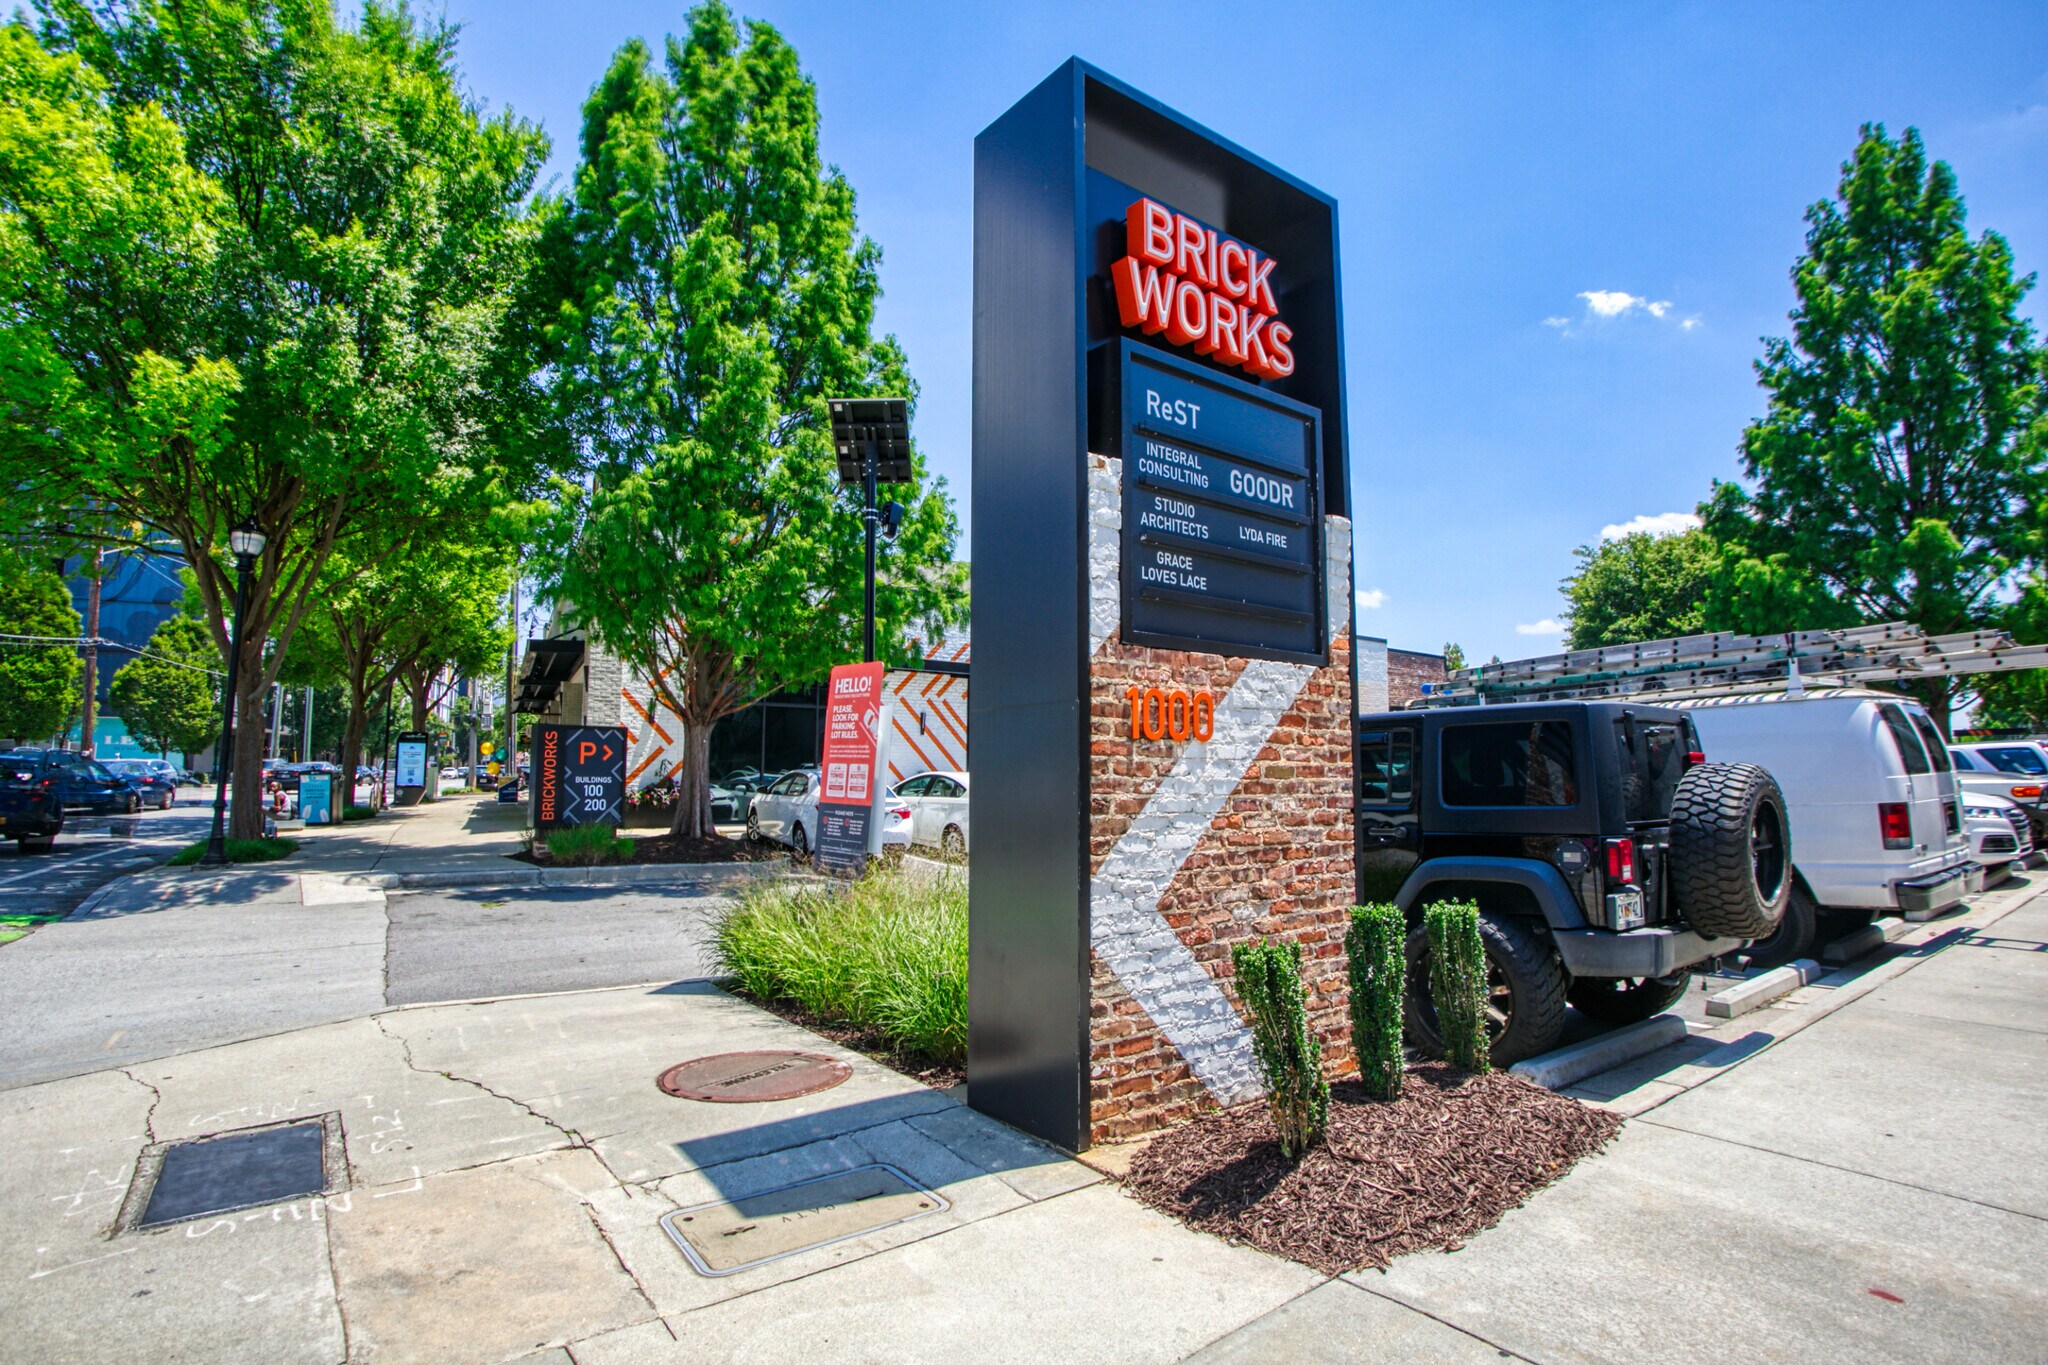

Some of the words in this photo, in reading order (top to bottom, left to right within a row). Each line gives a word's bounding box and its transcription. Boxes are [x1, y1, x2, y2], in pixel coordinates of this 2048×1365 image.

[1127, 197, 1279, 316] BRICK
[1111, 256, 1294, 380] WORKS
[1146, 389, 1200, 430] ReST
[1146, 441, 1202, 470] INTEGRAL
[1139, 458, 1209, 489] CONSULTING
[1229, 469, 1294, 508] GOODR
[1154, 497, 1195, 519] STUDIO
[1140, 511, 1209, 539] ARCHITECTS
[1239, 526, 1264, 544] LYDA
[1266, 533, 1287, 549] FIRE
[1156, 551, 1192, 571] GRACE
[1141, 566, 1177, 585] LOVES
[1180, 573, 1207, 591] LACE
[834, 676, 872, 694] HELLO!
[832, 714, 847, 722] LOOK
[848, 713, 859, 721] FOR
[1126, 685, 1214, 743] 1000
[830, 731, 841, 739] LOT
[841, 731, 858, 739] RULES.
[831, 722, 855, 730] PARKING
[579, 741, 597, 765] P
[541, 730, 558, 821] BRICKWORKS
[575, 776, 612, 784] BUILDINGS
[583, 784, 603, 797] 100
[584, 798, 607, 811] 200
[782, 1203, 836, 1223] CATV
